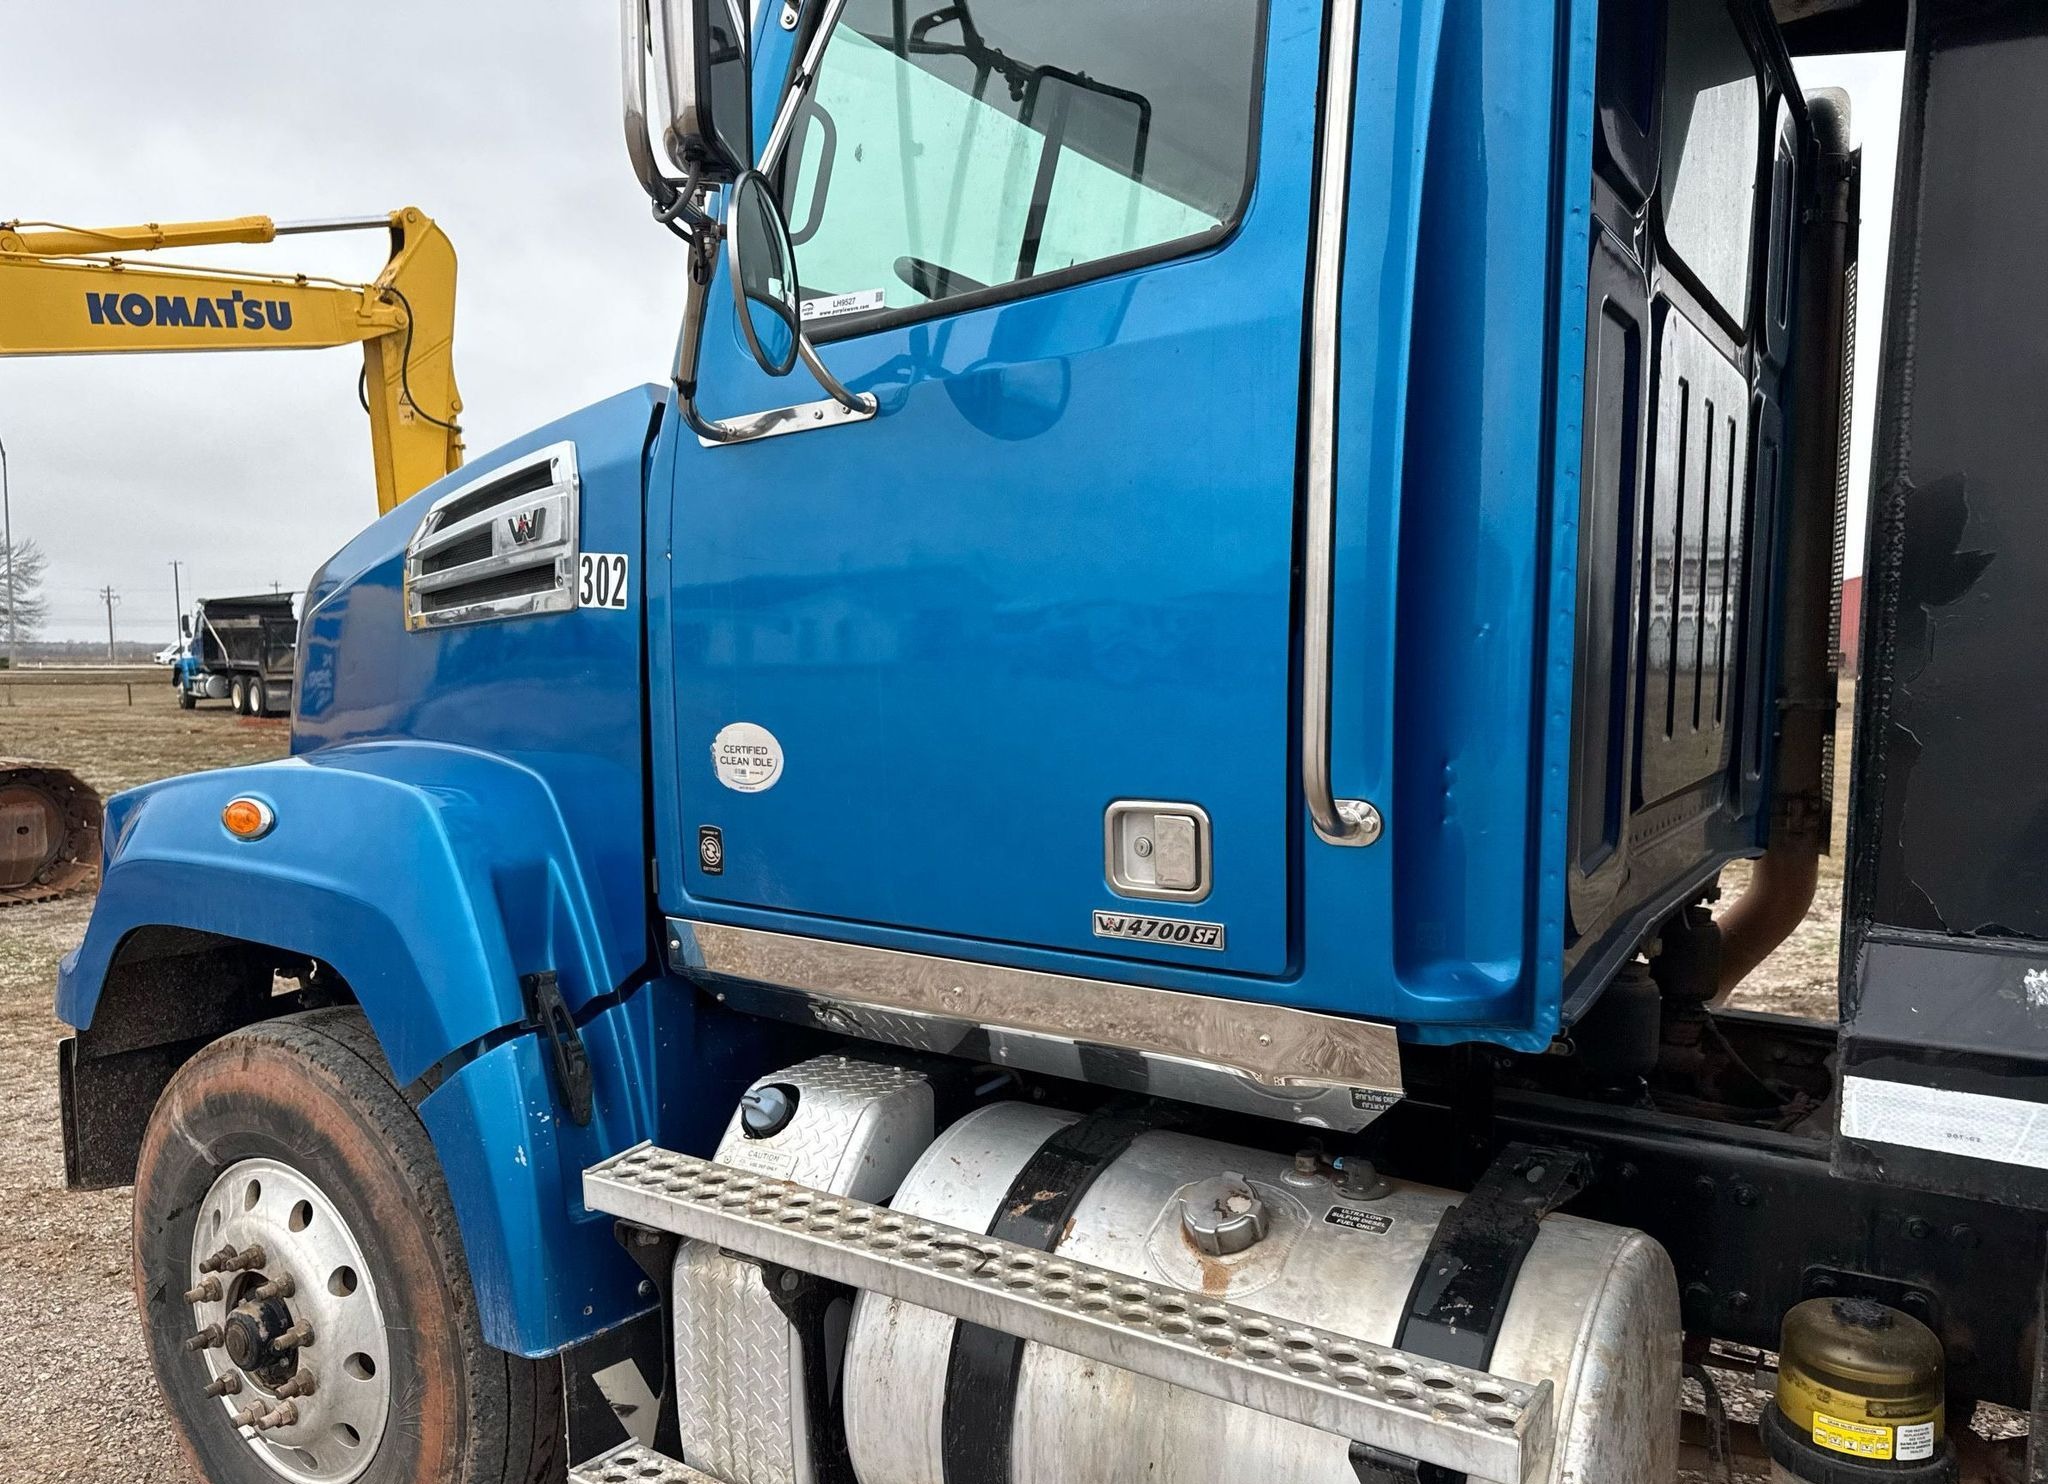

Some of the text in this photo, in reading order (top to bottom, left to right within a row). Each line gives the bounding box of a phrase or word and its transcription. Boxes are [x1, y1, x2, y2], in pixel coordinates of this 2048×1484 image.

[832, 297, 856, 308] LH9527
[86, 290, 292, 331] KOMATSU
[580, 555, 626, 608] 302
[723, 744, 768, 755] CERTIFIED
[720, 756, 773, 767] CLEAN IDLE
[748, 1150, 780, 1161] CAUTION
[1341, 1209, 1365, 1217] ULTRA
[1331, 1211, 1385, 1228] SULFUR DIESEL
[1336, 1218, 1376, 1230] FUEL ONLY
